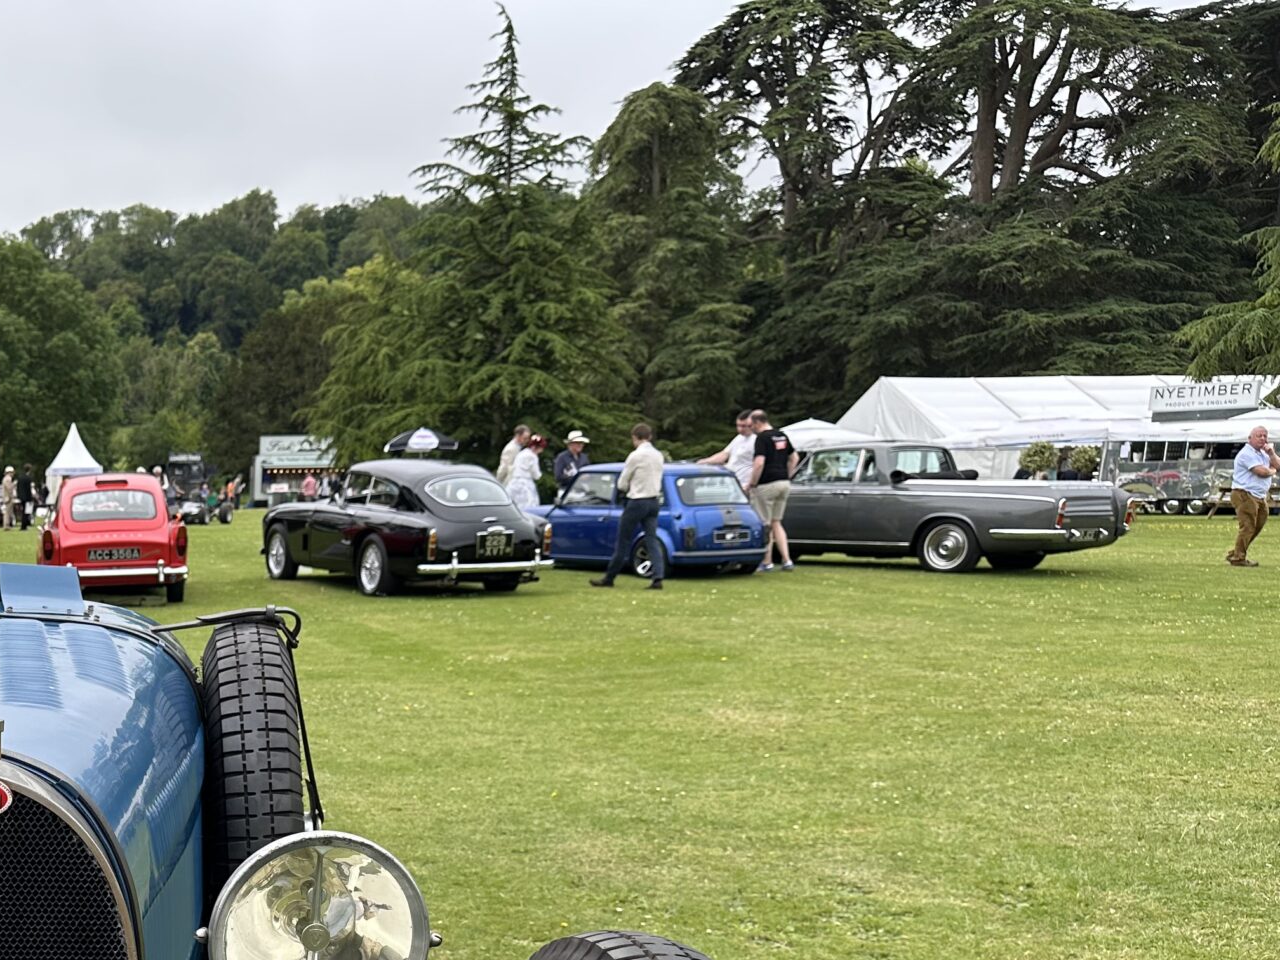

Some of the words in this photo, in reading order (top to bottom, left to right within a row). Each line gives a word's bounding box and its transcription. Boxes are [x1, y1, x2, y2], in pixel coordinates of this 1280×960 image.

[1154, 383, 1252, 399] NYETIMBER
[1165, 400, 1195, 408] PRODUCT
[1206, 399, 1238, 407] ENGLAND
[89, 550, 110, 560] ACC
